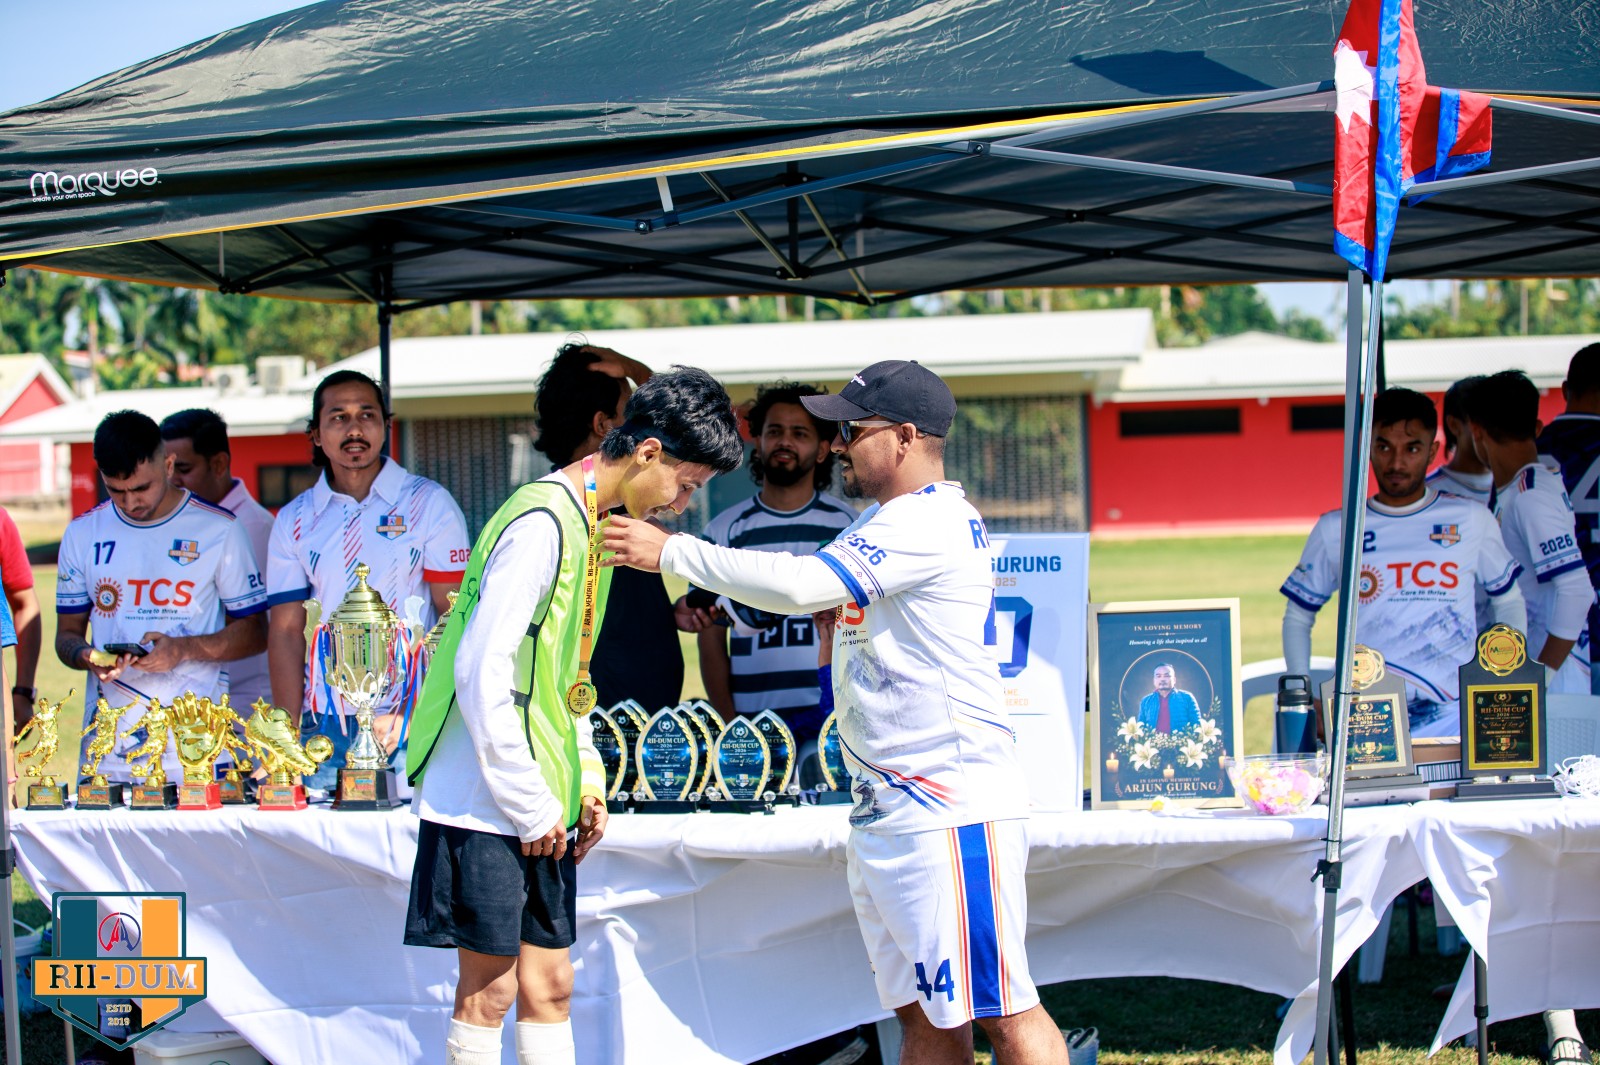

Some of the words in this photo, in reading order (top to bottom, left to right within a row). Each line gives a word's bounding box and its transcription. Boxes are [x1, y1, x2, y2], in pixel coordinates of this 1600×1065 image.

[30, 167, 158, 197] Marquee
[32, 195, 51, 203] create
[78, 192, 96, 200] space
[94, 541, 116, 566] 17
[1539, 533, 1574, 556] 2026
[1387, 561, 1459, 589] TCS
[128, 578, 196, 607] TCS
[585, 579, 594, 607] MEMORIAL
[1124, 783, 1162, 793] ARJUN
[1167, 781, 1217, 793] GURUNG
[915, 958, 955, 1002] 44
